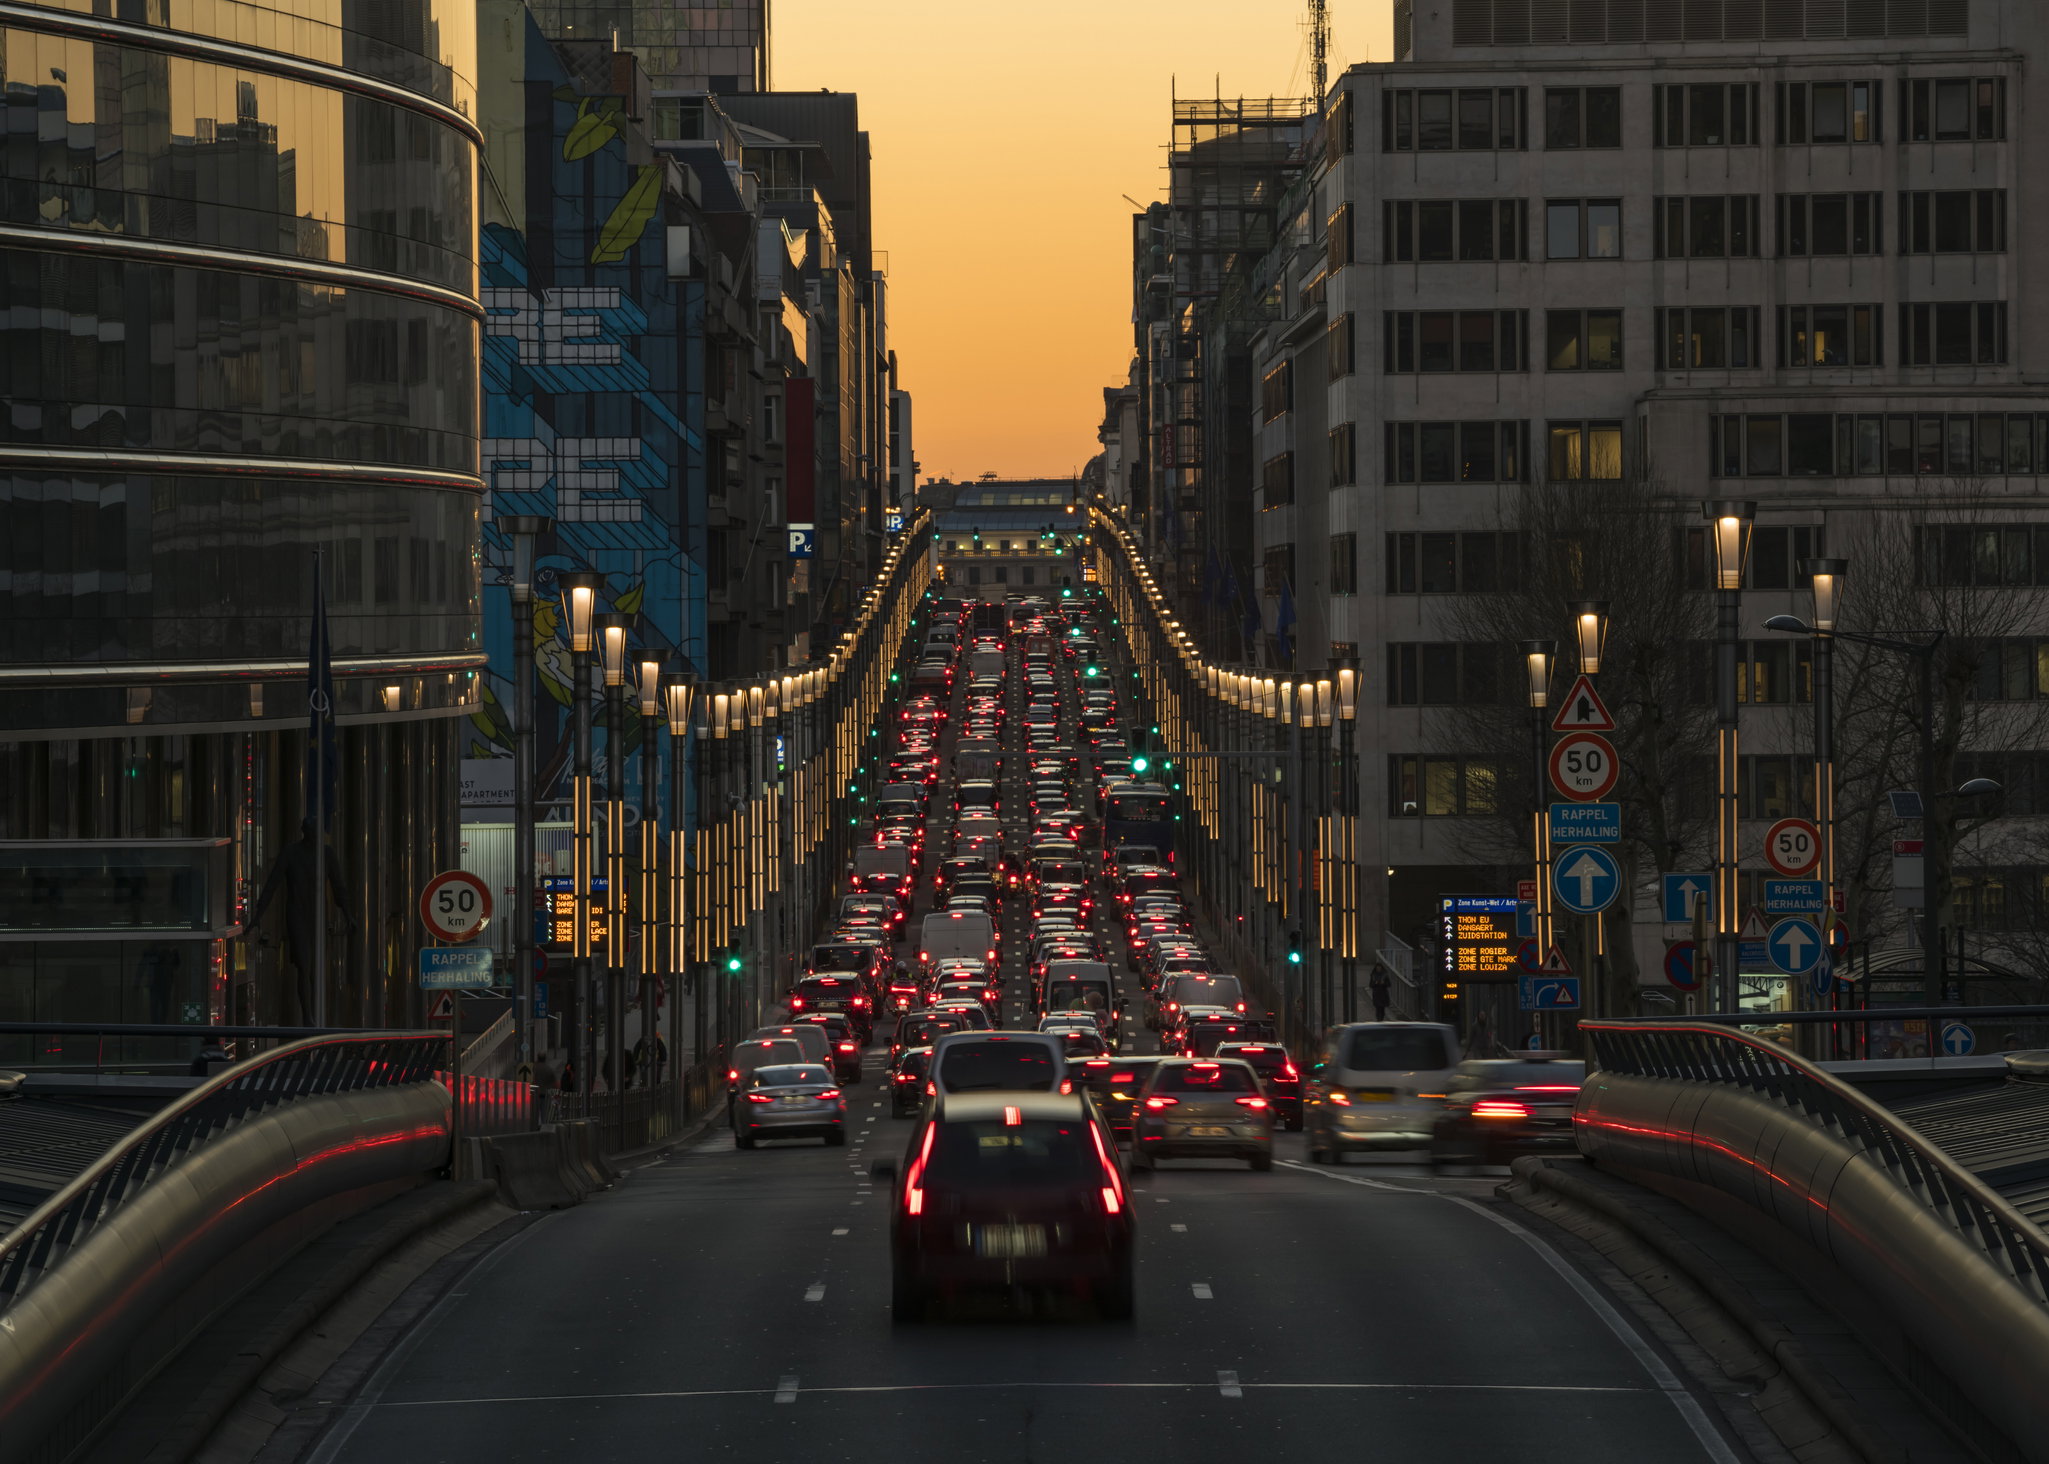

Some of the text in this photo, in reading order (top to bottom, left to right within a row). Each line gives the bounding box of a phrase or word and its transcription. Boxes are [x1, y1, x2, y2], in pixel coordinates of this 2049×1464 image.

[1165, 426, 1173, 464] ALTRAD
[789, 531, 806, 552] P
[1567, 750, 1601, 773] 50
[1575, 776, 1593, 786] km
[1562, 809, 1608, 820] RAPPEL
[1553, 826, 1618, 837] HERHALING
[1779, 833, 1808, 853] 50
[1787, 855, 1801, 864] km
[1774, 884, 1814, 895] RAPPEL
[438, 889, 474, 913] 50
[1767, 899, 1822, 909] HERHALING
[447, 916, 465, 927] km
[1458, 916, 1490, 924] THON EU
[1458, 932, 1507, 940] ZUIDSTATION
[432, 953, 480, 965] RAPPEL
[1458, 963, 1508, 971] ZONE LOUIZA
[422, 972, 491, 983] HERHALING
